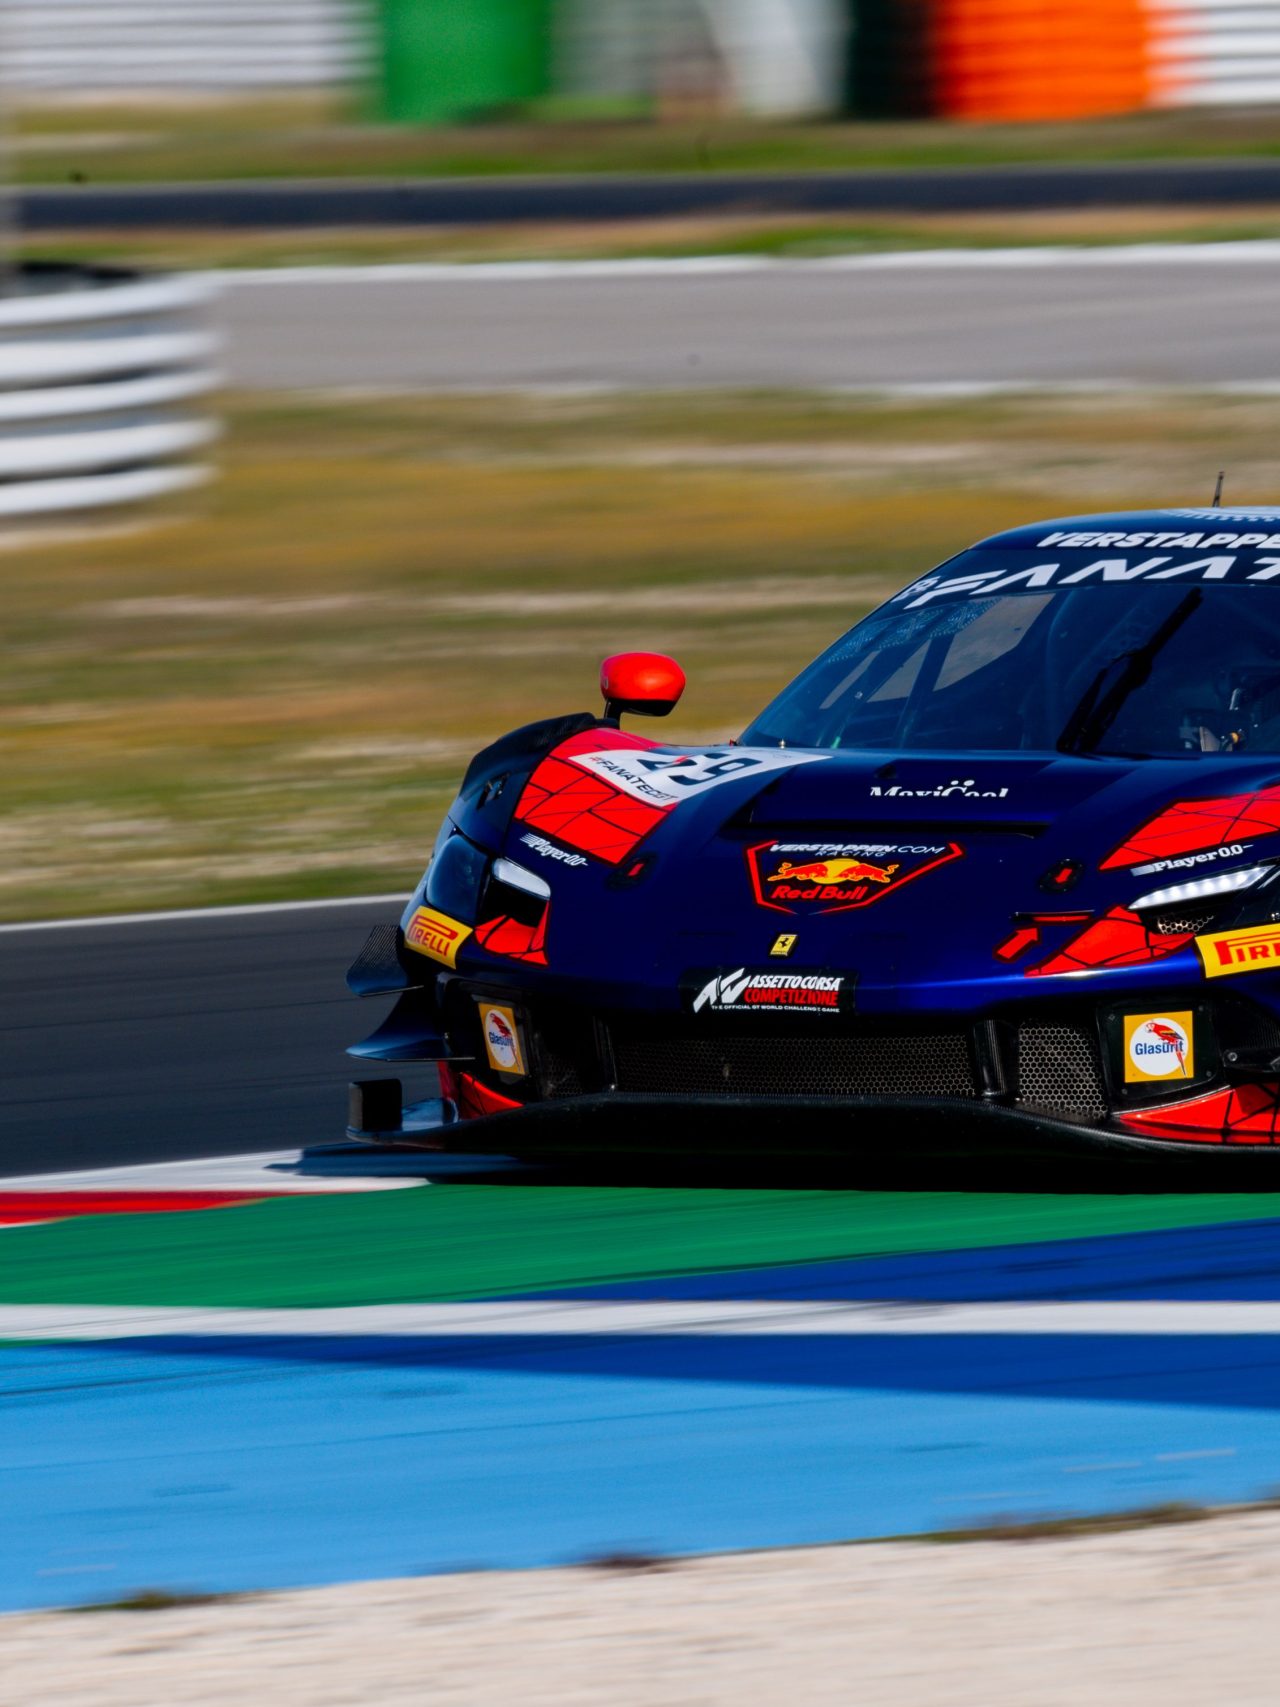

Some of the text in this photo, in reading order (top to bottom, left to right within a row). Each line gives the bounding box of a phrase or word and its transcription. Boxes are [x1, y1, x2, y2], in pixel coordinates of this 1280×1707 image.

[770, 844, 946, 855] VERSTAPPEN.COM
[1154, 851, 1218, 872] Player
[771, 885, 869, 901] Red Bull
[408, 914, 458, 958] PIRELLI
[748, 975, 840, 992] ASSETTO CORSA
[744, 987, 839, 1007] COMPETIZIONE
[1134, 1040, 1184, 1056] Glasurit
